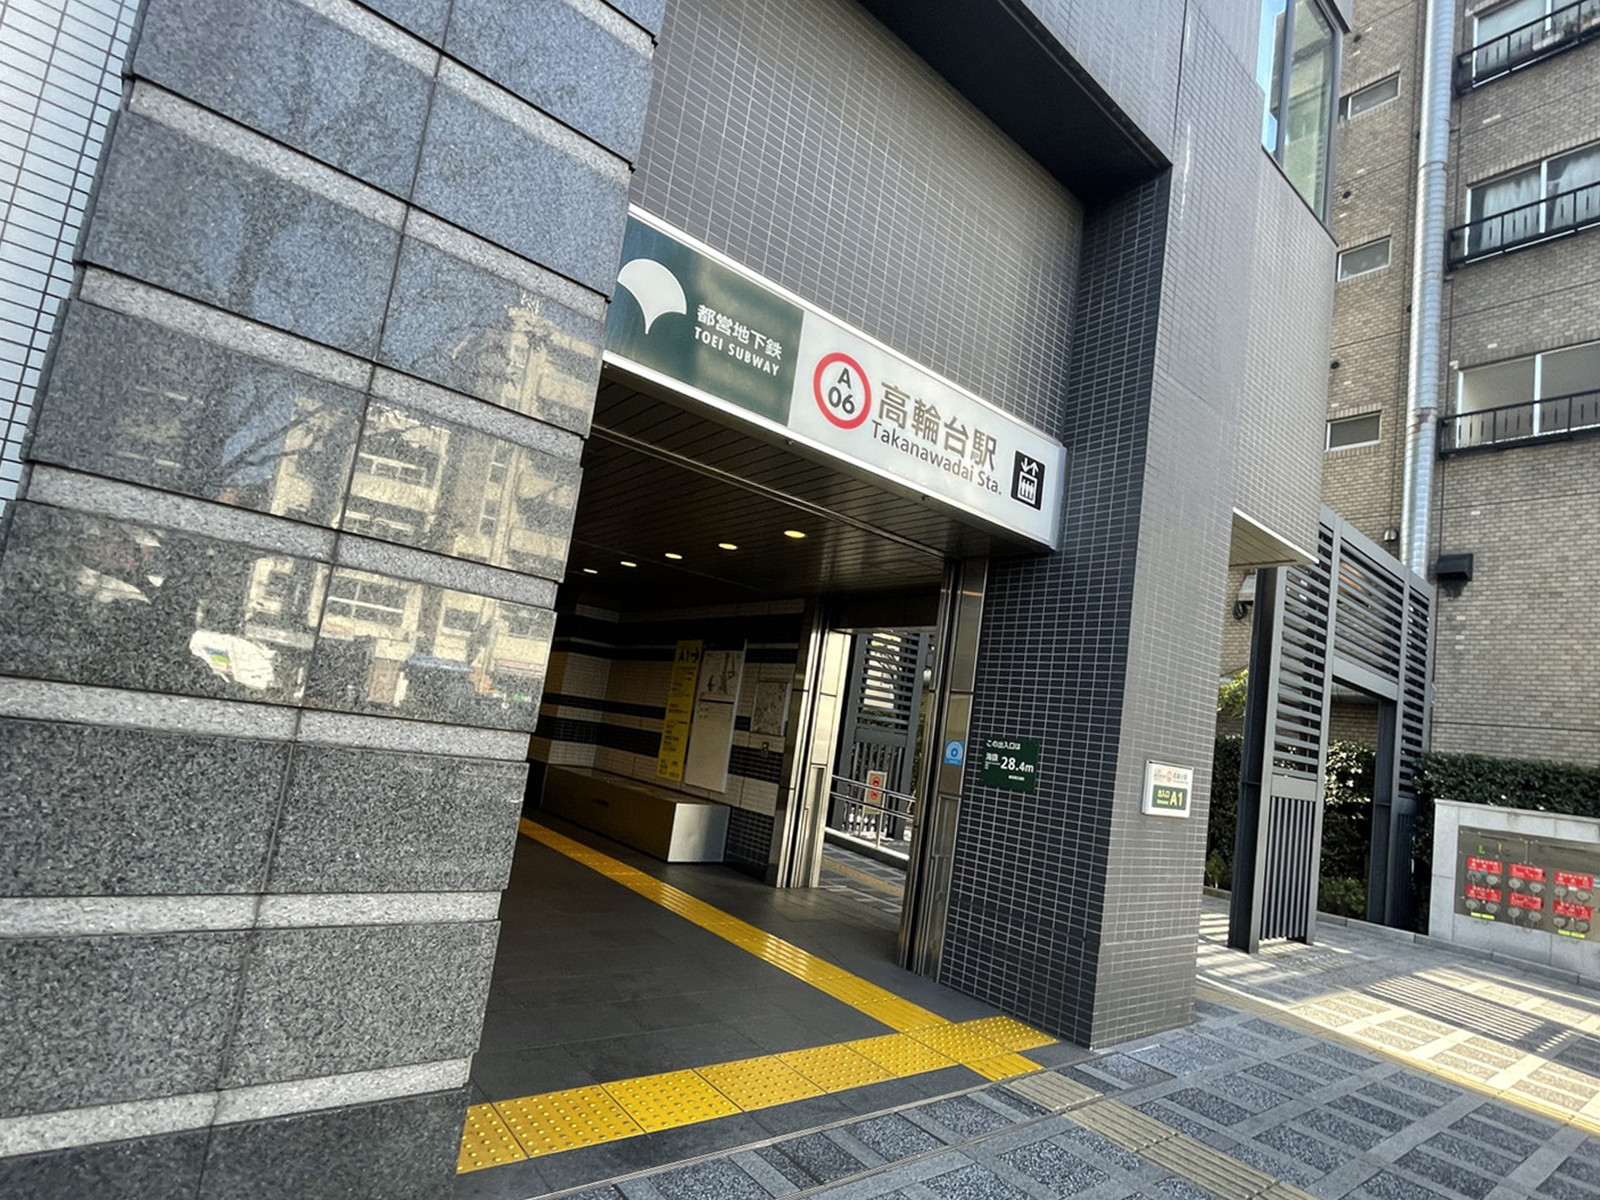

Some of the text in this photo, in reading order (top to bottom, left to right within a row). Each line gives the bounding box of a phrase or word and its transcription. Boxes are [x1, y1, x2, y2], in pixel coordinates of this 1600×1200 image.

[694, 326, 779, 376] TOEI SUBWAY
[697, 304, 782, 360] 都営地下鉄
[837, 367, 852, 389] A
[828, 386, 855, 415] 06
[878, 381, 997, 472] 高輪台駅
[872, 420, 1002, 495] Takanawadai Sta.
[1000, 755, 1035, 773] 28.4m
[1170, 791, 1183, 806] A1
